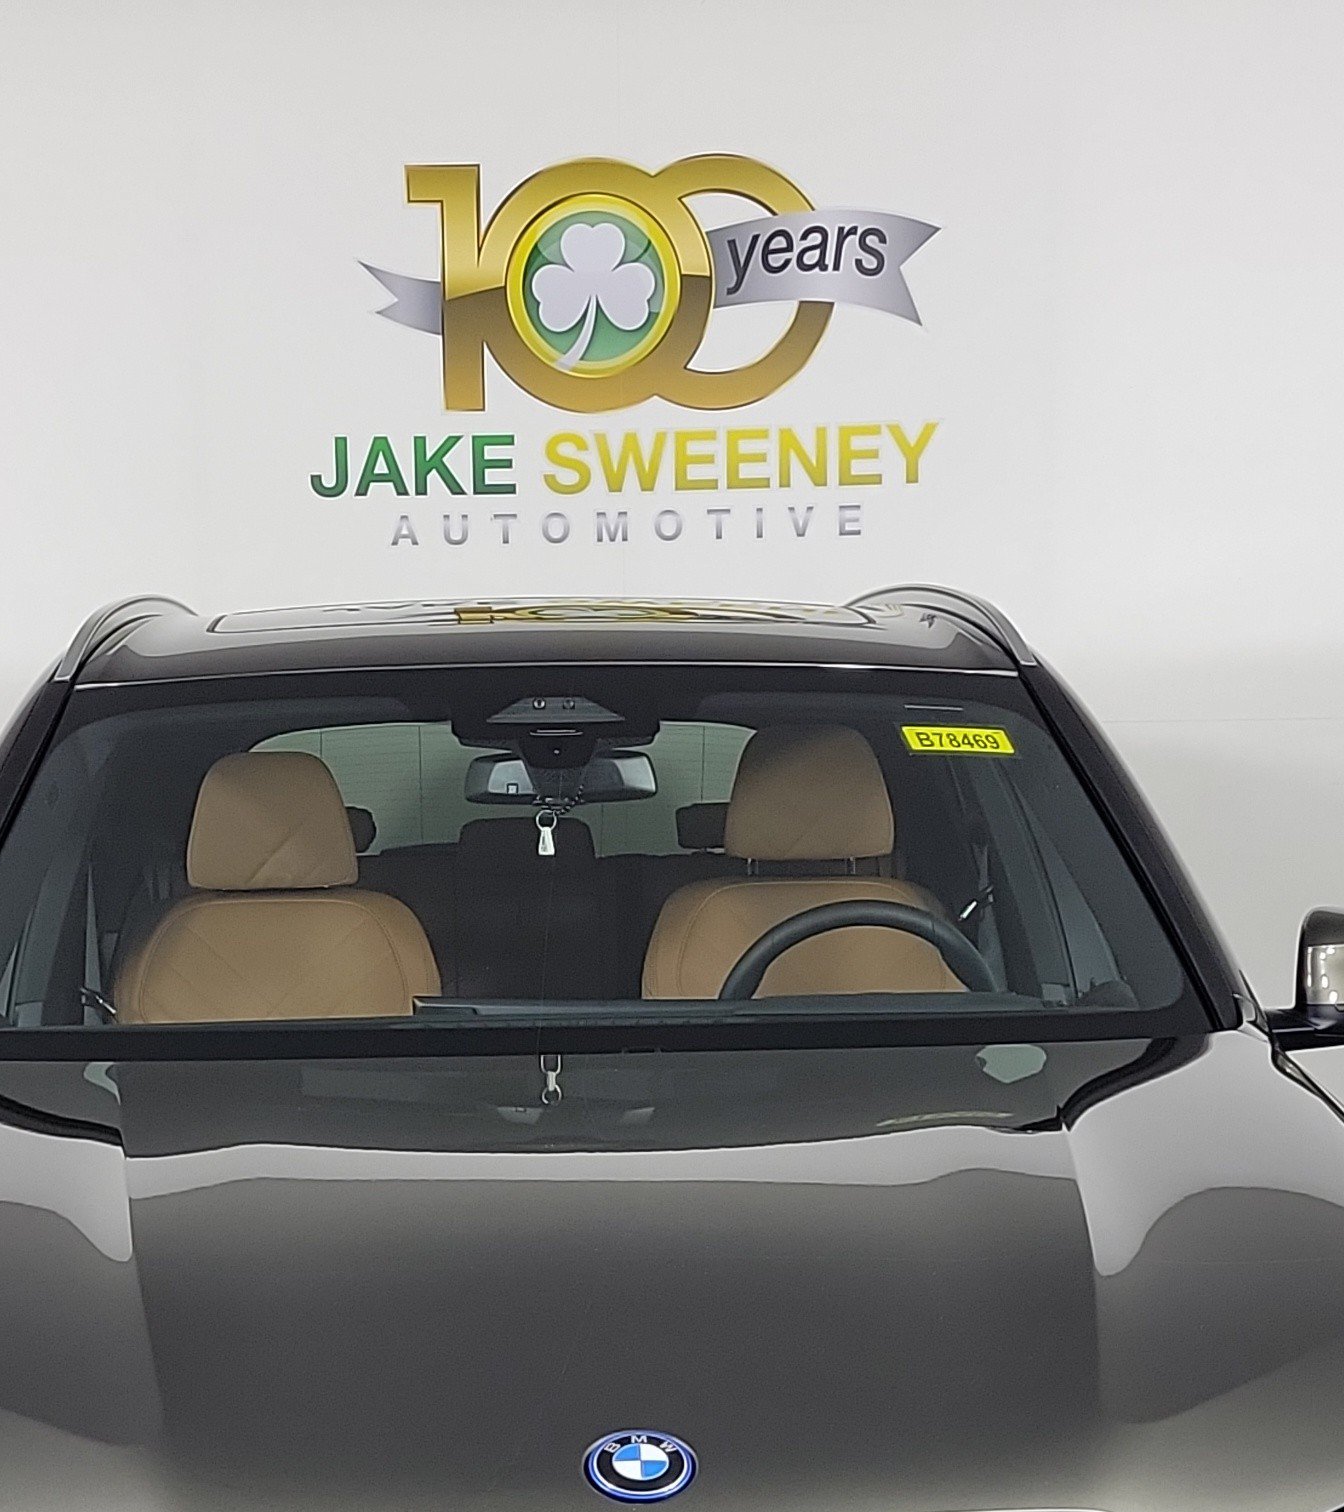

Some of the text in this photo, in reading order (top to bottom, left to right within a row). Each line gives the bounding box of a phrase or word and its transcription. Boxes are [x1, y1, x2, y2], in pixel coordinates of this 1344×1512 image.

[404, 153, 887, 412] 100 years
[310, 422, 939, 498] JAKE SWEENEY
[391, 504, 863, 546] AUTOMOTIVE
[916, 731, 1000, 749] B78469
[604, 1435, 677, 1453] BMW
